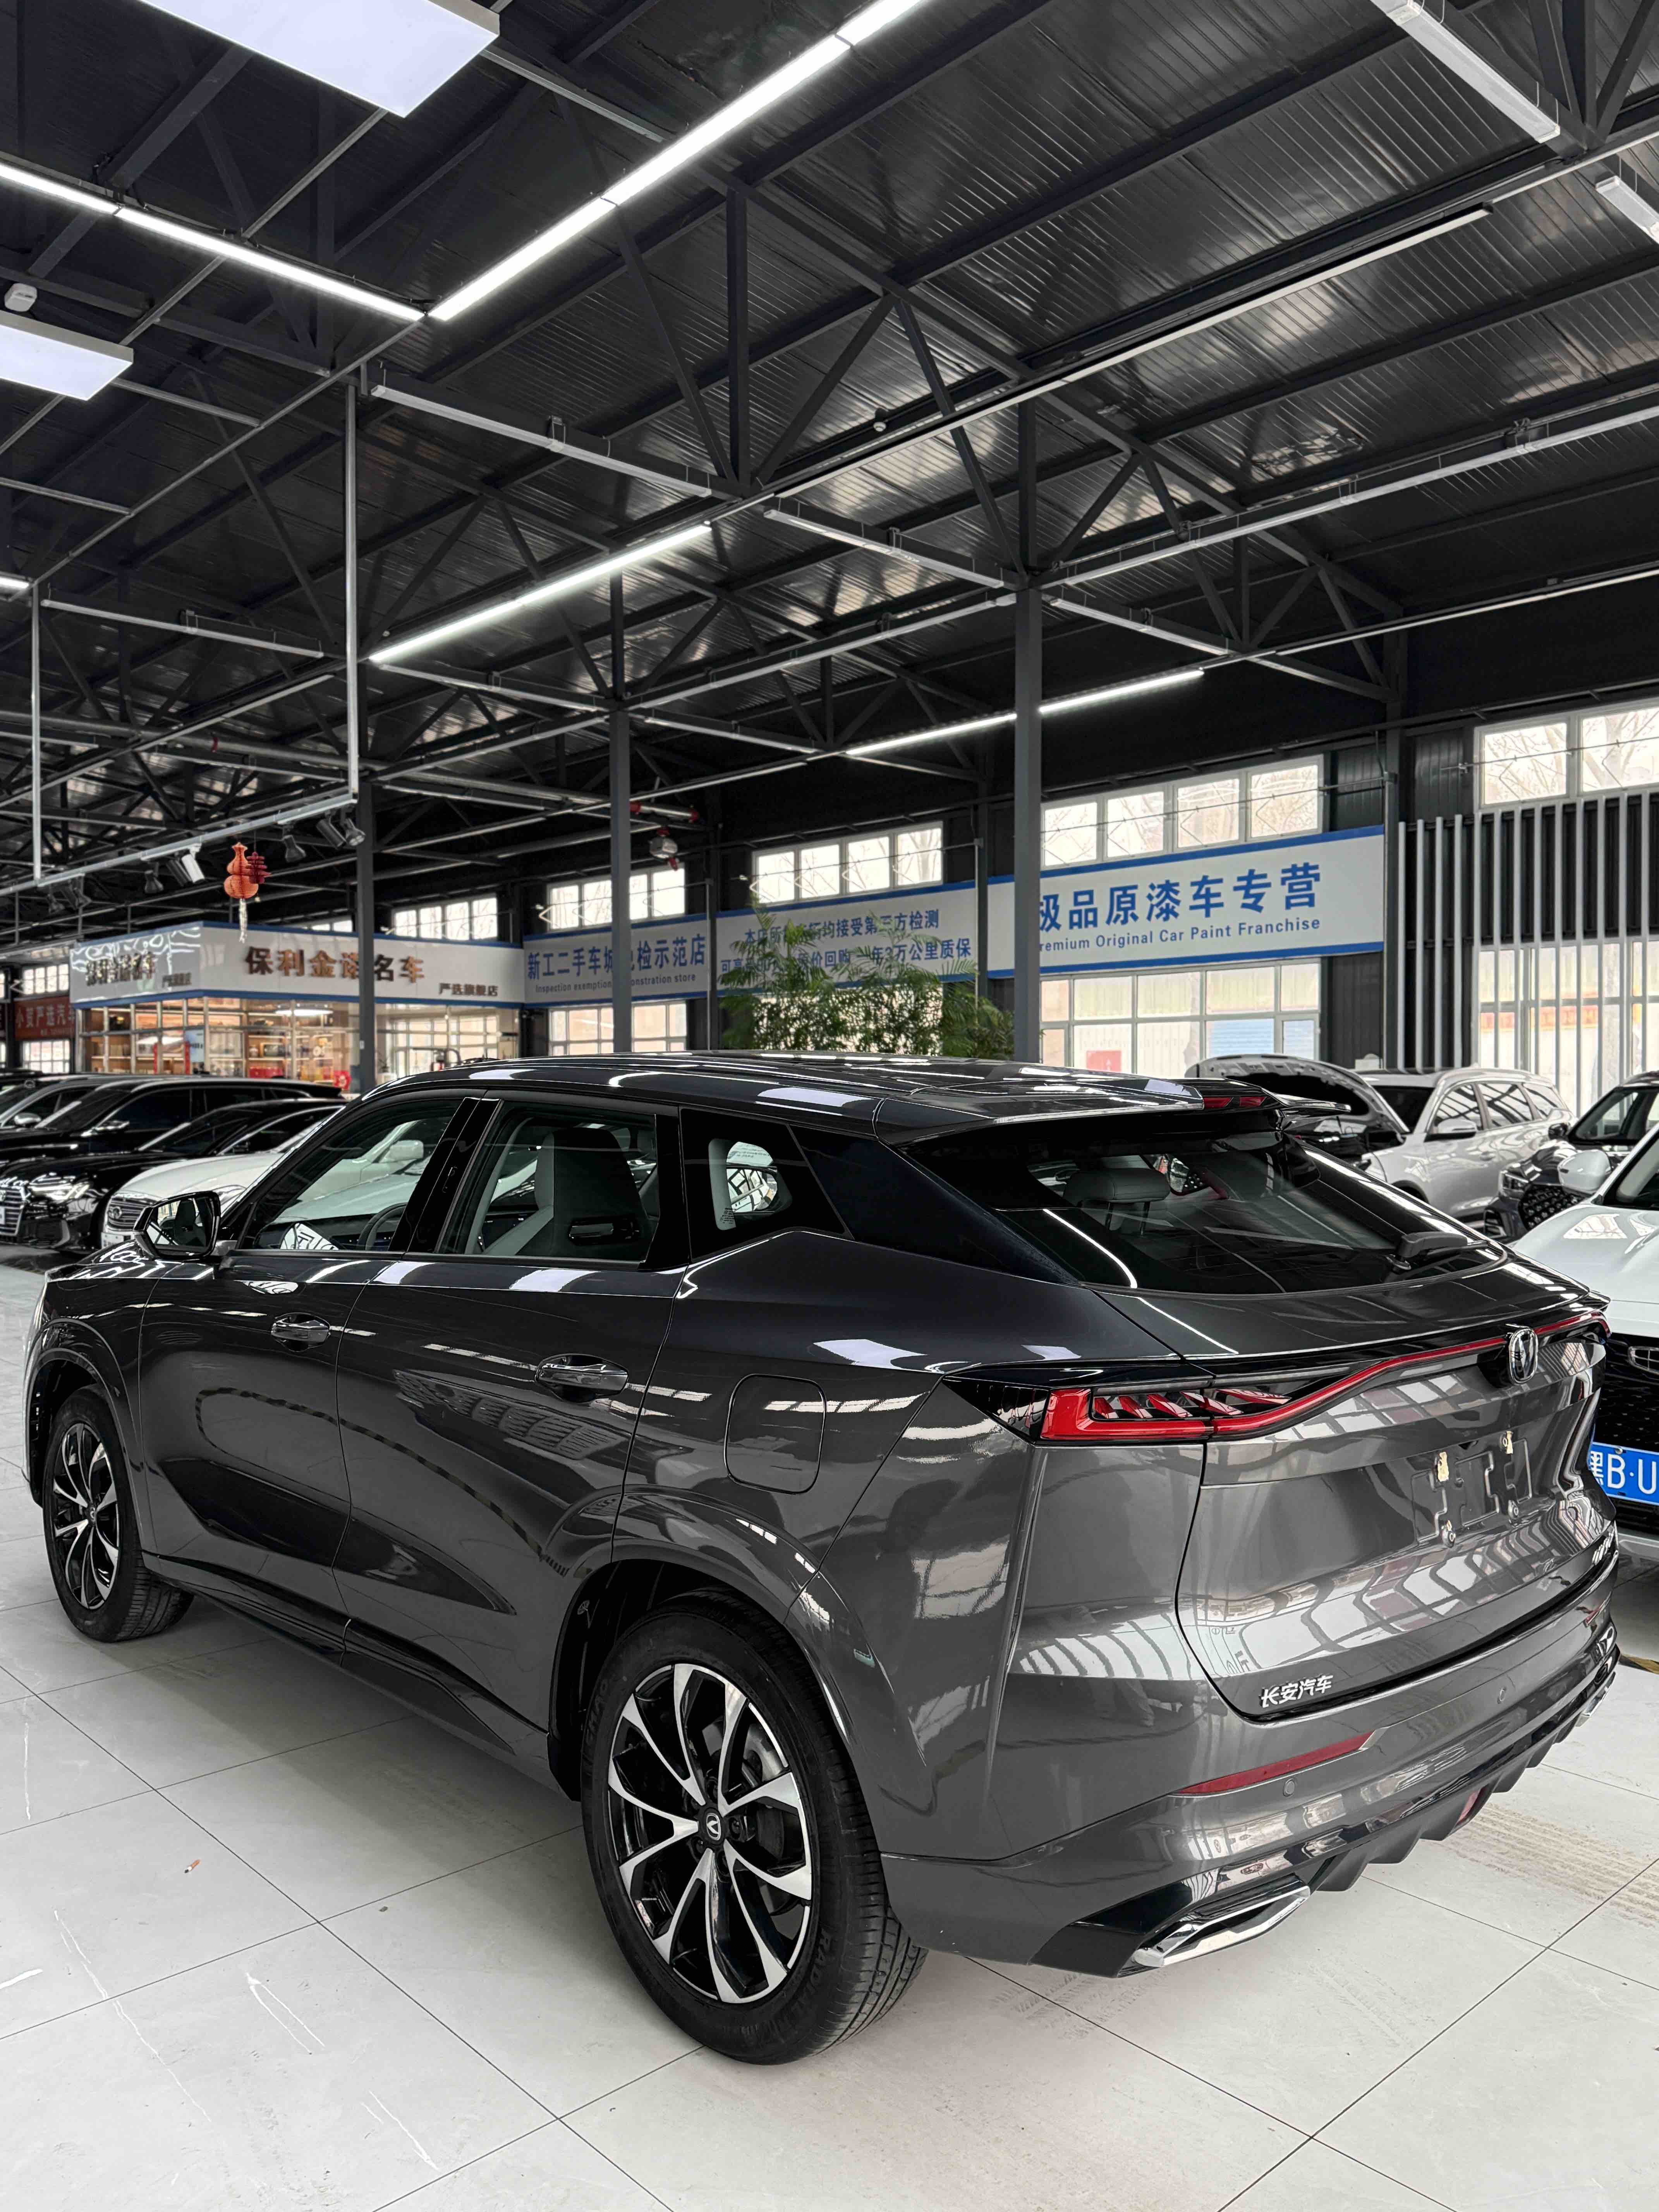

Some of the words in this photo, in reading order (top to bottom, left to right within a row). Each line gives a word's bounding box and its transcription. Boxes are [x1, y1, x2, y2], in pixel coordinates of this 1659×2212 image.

[1040, 937, 1090, 951] remium
[1096, 931, 1153, 948] Original
[1159, 929, 1184, 942] Car
[1191, 925, 1231, 940] Paint
[1239, 917, 1320, 936] Franchise
[527, 934, 706, 980] 新工二手车城检示范店
[536, 982, 571, 994] Inspection
[574, 981, 611, 991] exemption
[630, 974, 672, 986] onstration
[675, 974, 696, 982] store
[1261, 1675, 1334, 1708] 长安汽车
